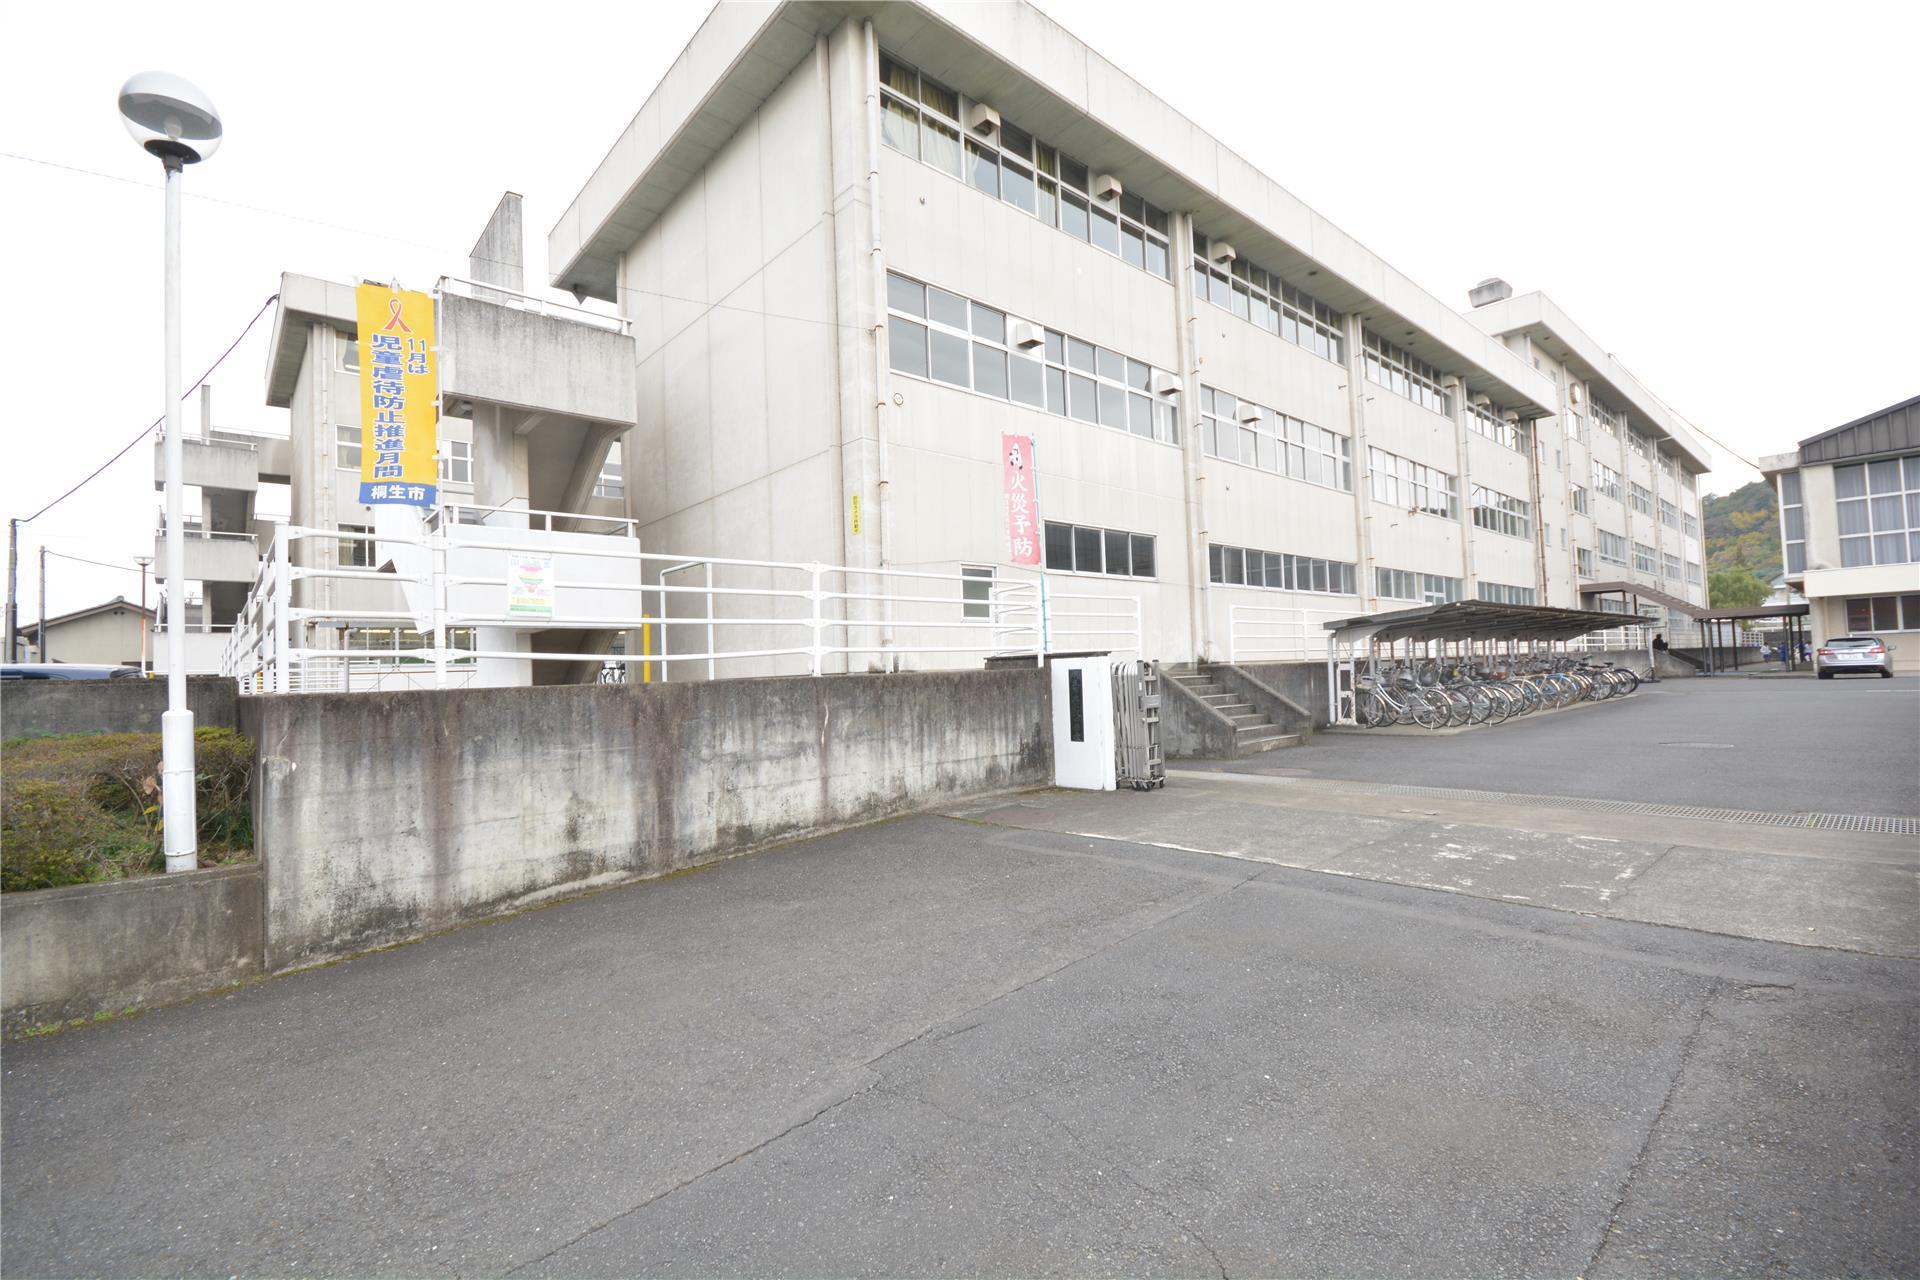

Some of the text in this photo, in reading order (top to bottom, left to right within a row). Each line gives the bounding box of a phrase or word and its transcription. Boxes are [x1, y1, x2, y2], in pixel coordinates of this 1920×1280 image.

[407, 338, 429, 374] 11月は
[371, 333, 405, 478] 児童虐待防止推進月間
[371, 484, 425, 502] 桐生市
[1010, 471, 1032, 557] 火災予防
